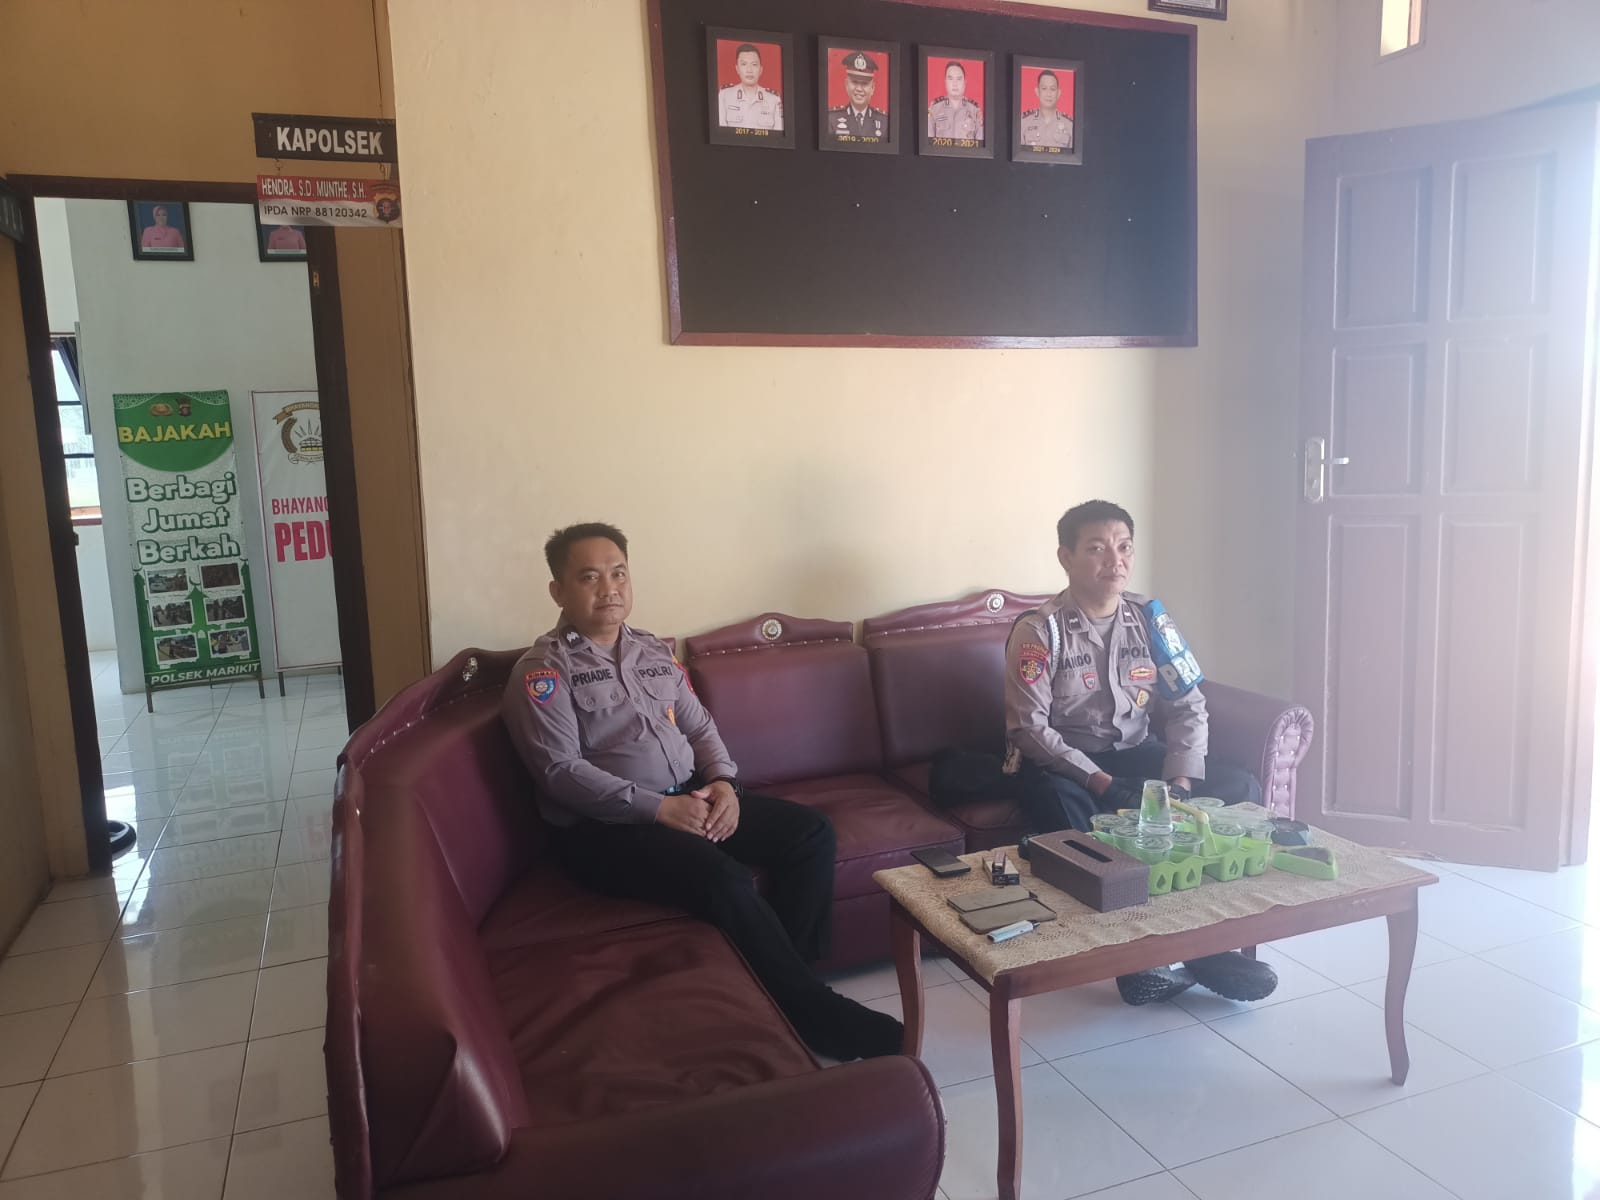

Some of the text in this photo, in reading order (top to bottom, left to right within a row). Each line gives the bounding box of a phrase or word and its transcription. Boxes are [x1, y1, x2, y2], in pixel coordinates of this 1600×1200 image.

[276, 126, 384, 155] KAPOLSEK
[261, 178, 296, 196] HENDRA.
[291, 206, 311, 217] NRP
[315, 207, 367, 218] 88120342
[118, 421, 231, 443] BAJAKAH
[126, 471, 236, 504] Berbagi
[142, 506, 230, 533] Jumat
[137, 533, 241, 565] Berkah
[151, 662, 260, 685] POLSEK MARIKIT
[571, 668, 613, 687] PRIADIE
[638, 665, 673, 679] POLRI
